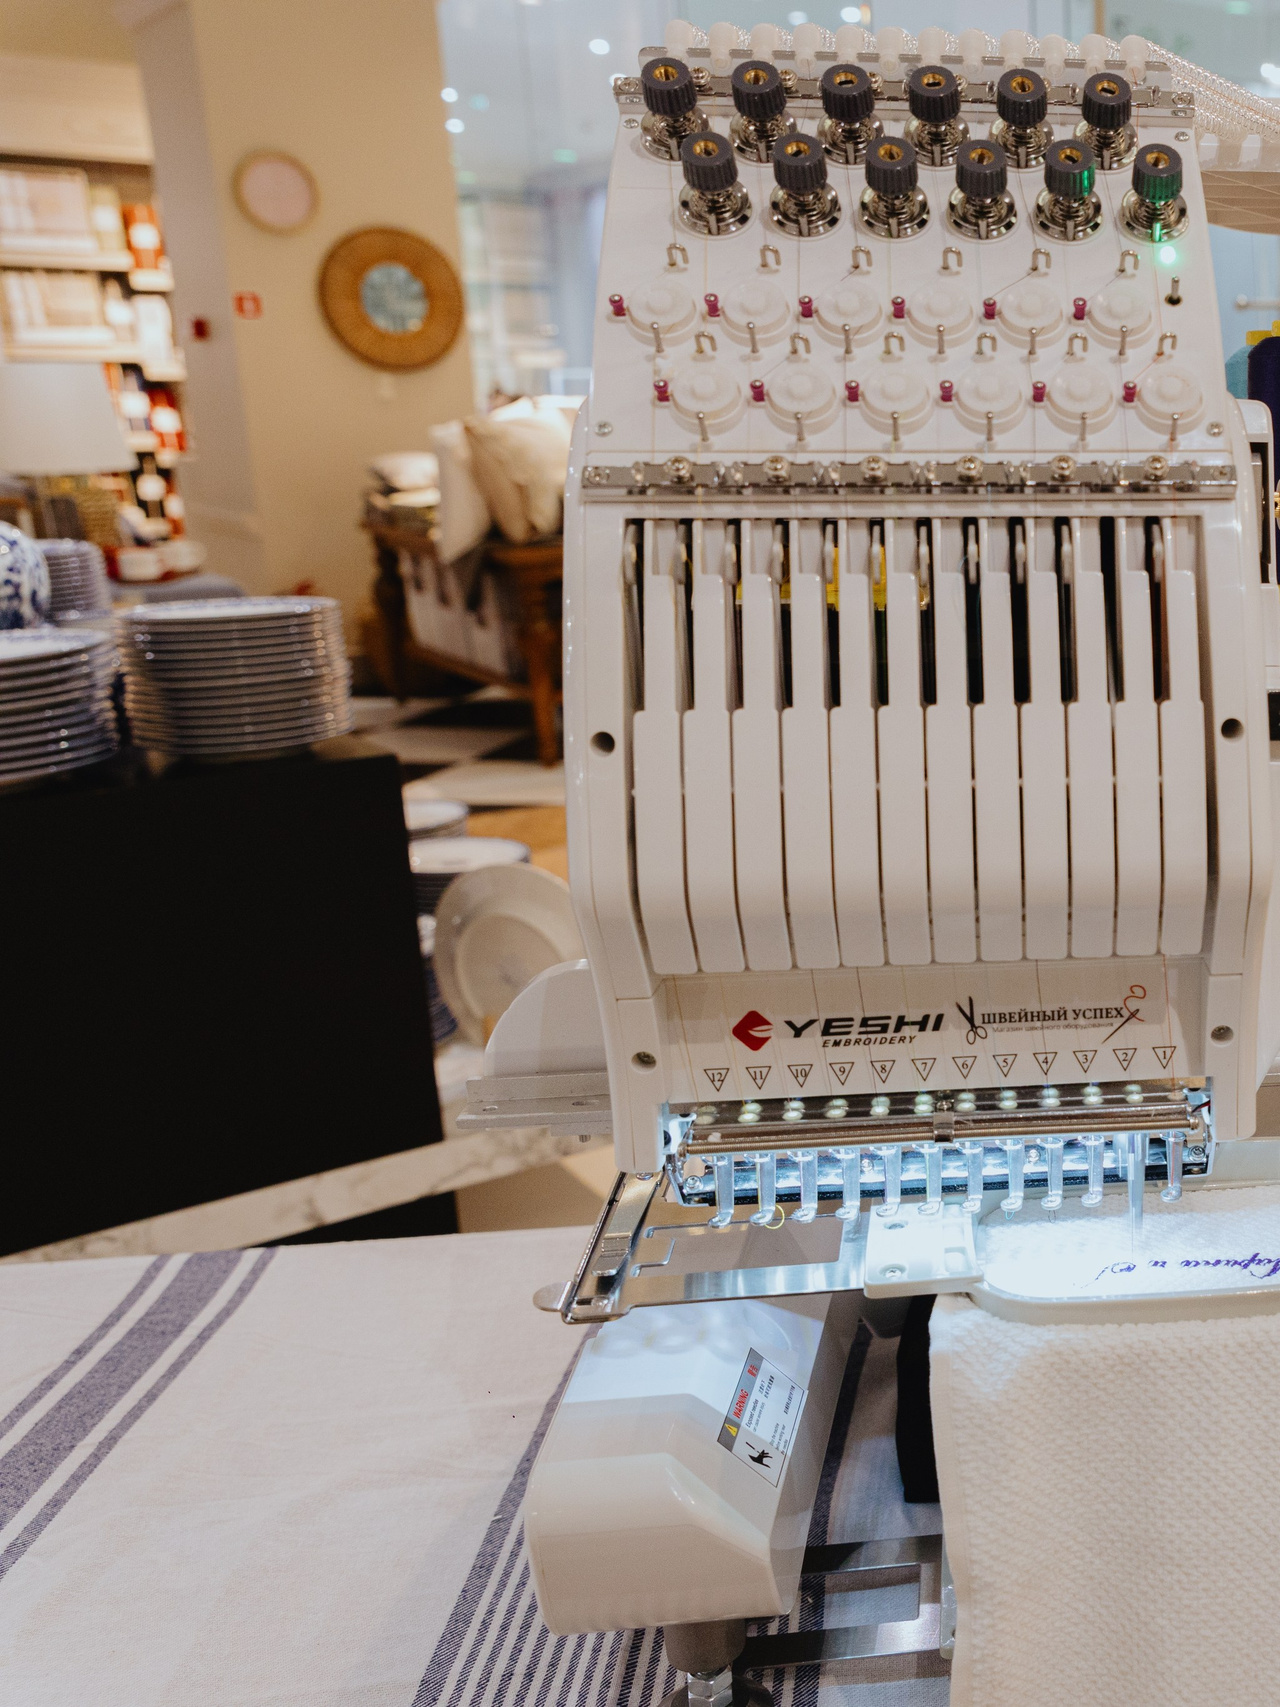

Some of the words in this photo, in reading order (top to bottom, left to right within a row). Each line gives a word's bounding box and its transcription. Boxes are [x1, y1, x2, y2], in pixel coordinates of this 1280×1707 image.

[784, 1013, 945, 1038] YESHI
[981, 1007, 1068, 1025] ШВЕЙНЫЙ
[1073, 1007, 1125, 1021] УСПЕХ
[822, 1035, 917, 1048] EMBROIDERY
[711, 1072, 723, 1083] 12
[753, 1071, 763, 1080] 11
[795, 1068, 807, 1079] 10
[839, 1066, 846, 1076] 9
[880, 1064, 887, 1074] 8
[921, 1062, 928, 1072] 7
[961, 1060, 969, 1070] 6
[1002, 1058, 1009, 1068] 5
[1042, 1056, 1049, 1065] 4
[1082, 1054, 1089, 1064] 3
[1122, 1052, 1129, 1062] 2
[733, 1389, 749, 1419] WARNING
